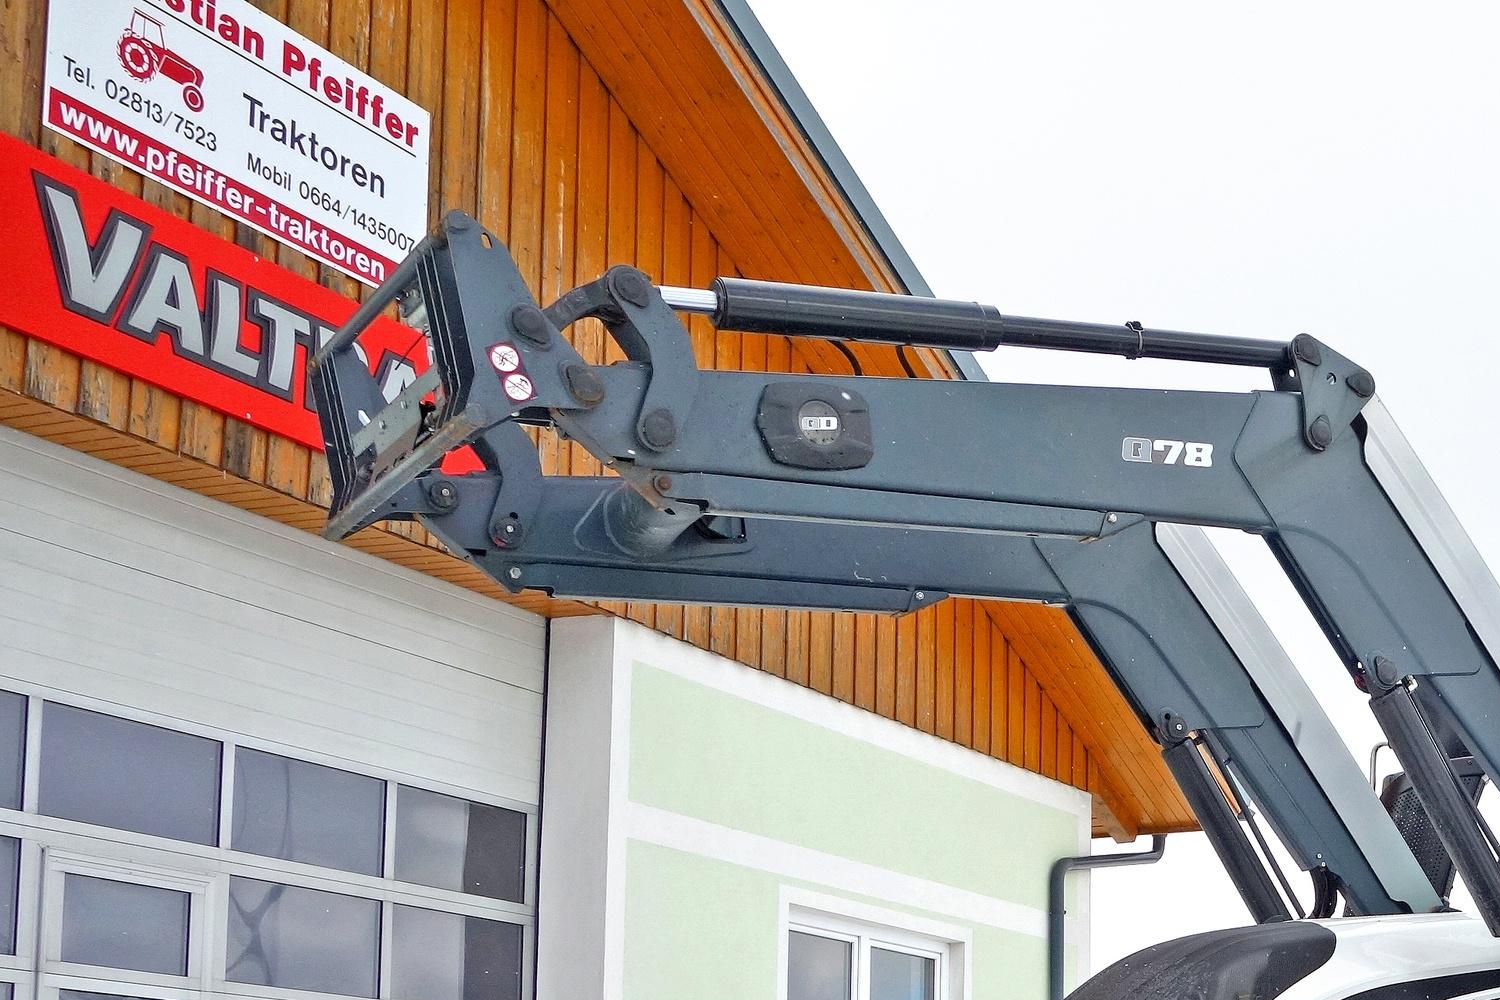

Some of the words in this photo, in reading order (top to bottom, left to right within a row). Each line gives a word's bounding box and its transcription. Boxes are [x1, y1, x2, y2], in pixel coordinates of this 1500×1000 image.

[63, 55, 95, 91] Tel.
[105, 79, 218, 152] 02813/7523
[242, 93, 386, 198] Traktoren
[282, 39, 419, 149] Pfeiffer
[59, 99, 385, 282] www.pfeiffer-traktoren
[247, 152, 292, 192] Mobil
[299, 181, 415, 252] 0664/1435007
